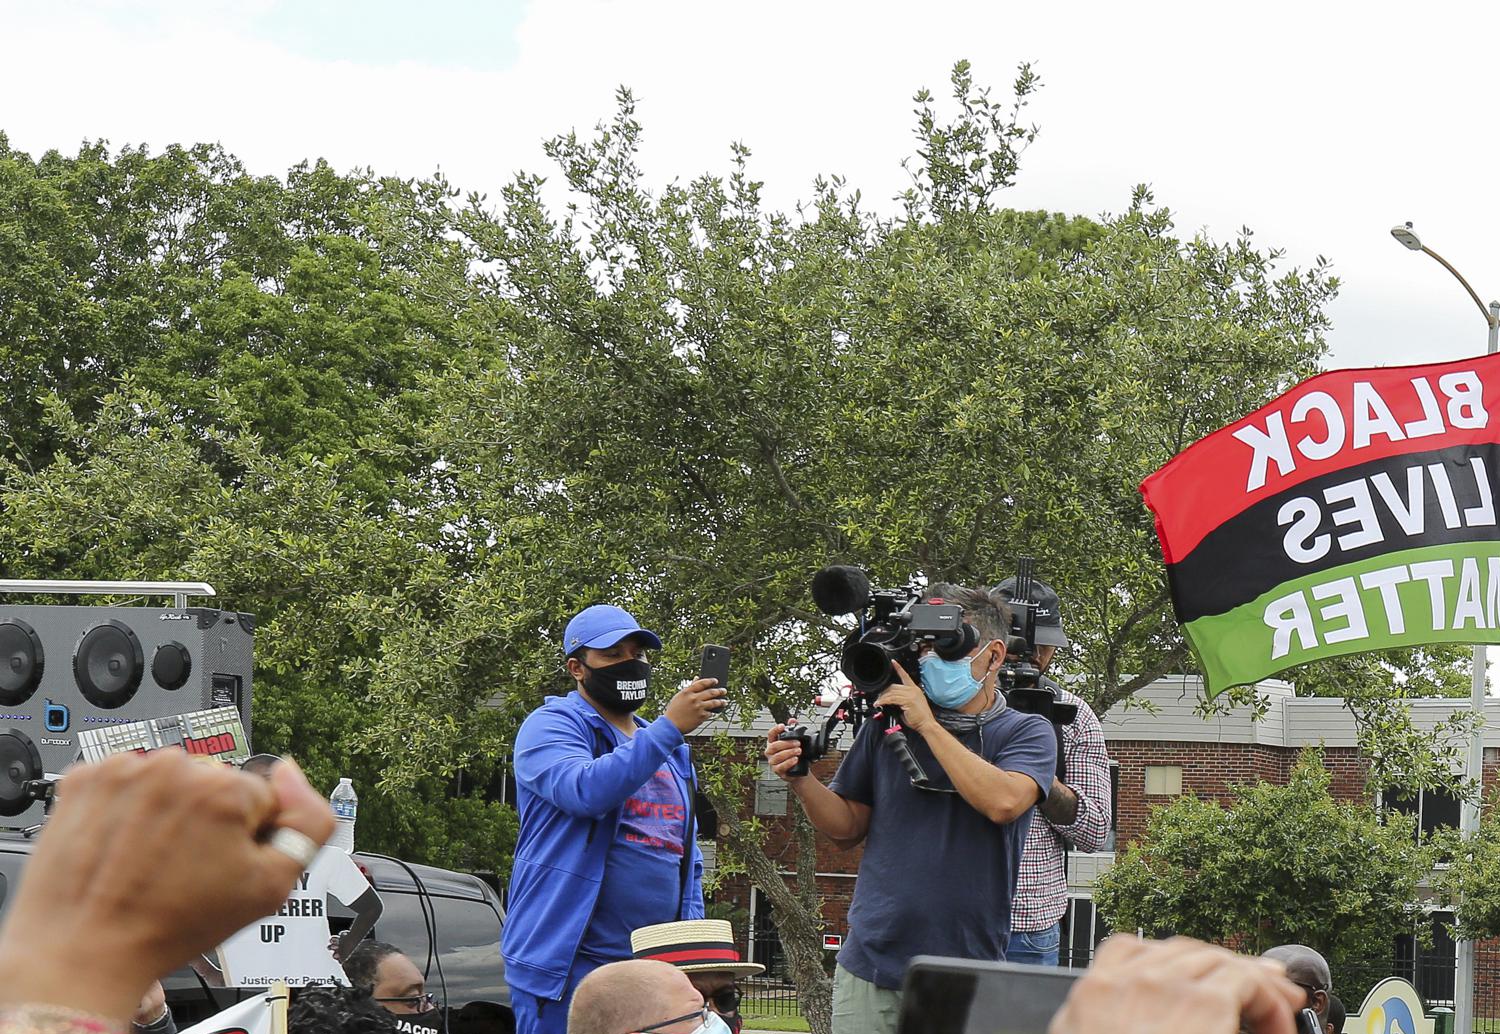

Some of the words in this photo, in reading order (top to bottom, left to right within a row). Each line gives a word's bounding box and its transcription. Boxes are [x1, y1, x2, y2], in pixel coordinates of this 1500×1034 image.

[616, 679, 647, 690] BREONNA
[620, 690, 646, 701] TAYLOR
[260, 925, 286, 943] UP
